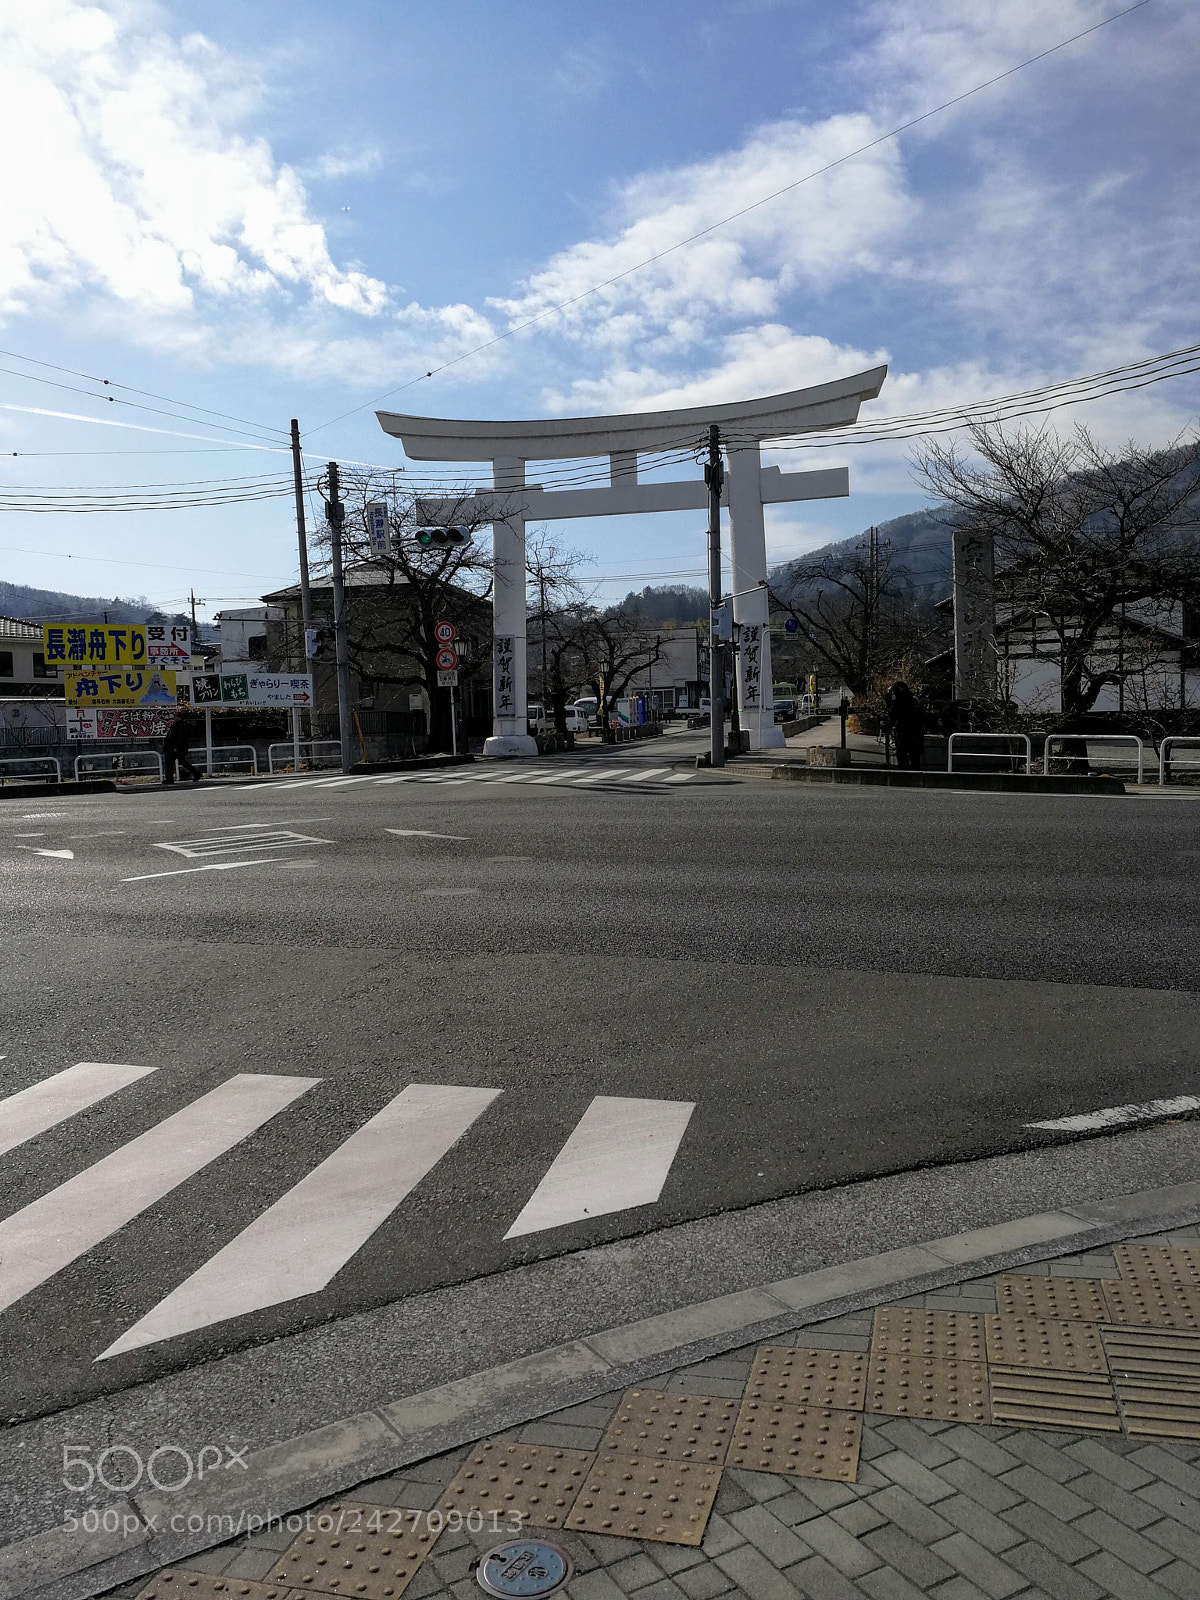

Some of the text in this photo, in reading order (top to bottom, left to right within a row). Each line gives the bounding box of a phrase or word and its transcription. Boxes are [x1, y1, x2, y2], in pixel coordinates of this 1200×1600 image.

[148, 626, 189, 642] 受付
[440, 628, 450, 637] 40
[46, 628, 145, 661] 長瀞舟下り
[149, 646, 179, 656] 事務所
[149, 657, 190, 665] すぐそこ
[742, 626, 760, 702] 謹賀新年
[496, 638, 513, 711] 謹賀新年
[75, 672, 143, 698] 舟下り
[223, 676, 243, 689] わらび
[249, 678, 309, 689] ぎゃらりー喫茶
[199, 688, 219, 700] プリン
[230, 688, 246, 699] もち
[120, 711, 153, 722] そば粉
[113, 721, 170, 737] たい焼
